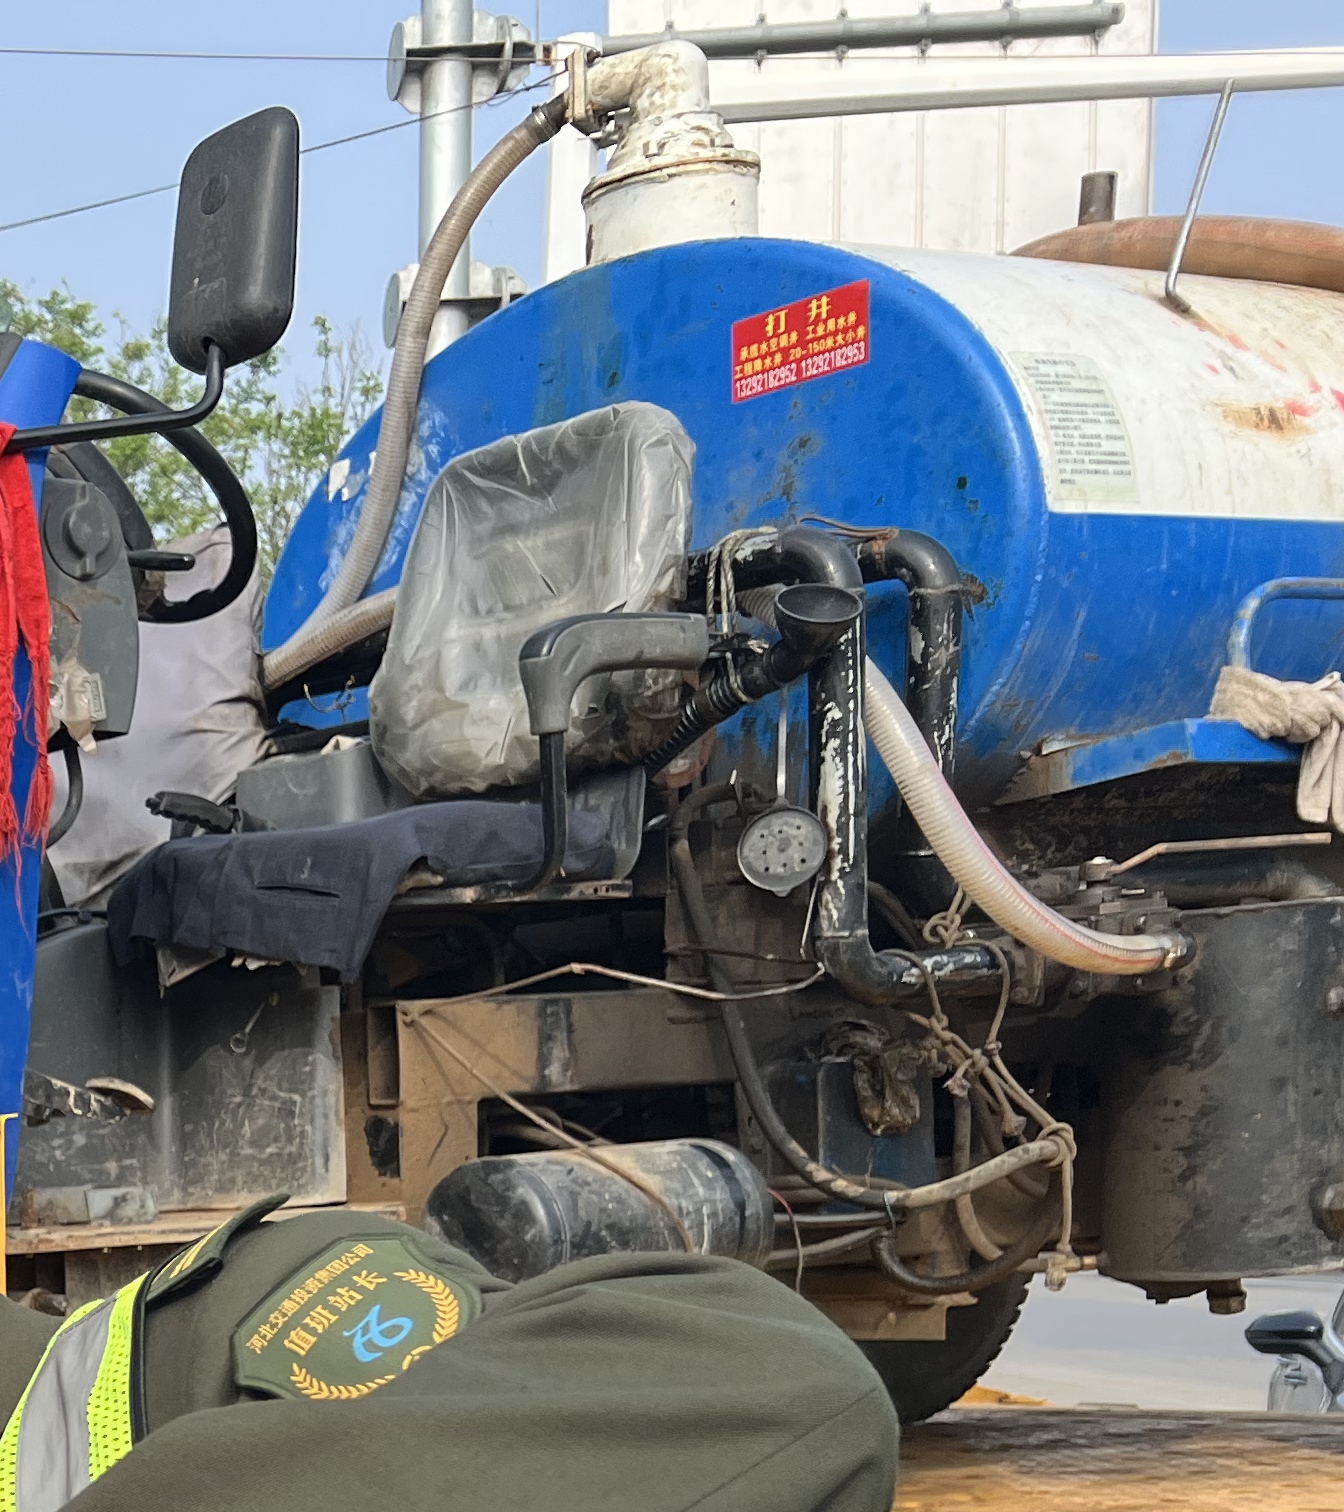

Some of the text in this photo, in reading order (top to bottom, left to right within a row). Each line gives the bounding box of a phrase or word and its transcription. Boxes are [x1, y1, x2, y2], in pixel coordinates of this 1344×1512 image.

[246, 1243, 374, 1354] 河北交通投资集团公司
[283, 1269, 388, 1357] 值班站长
